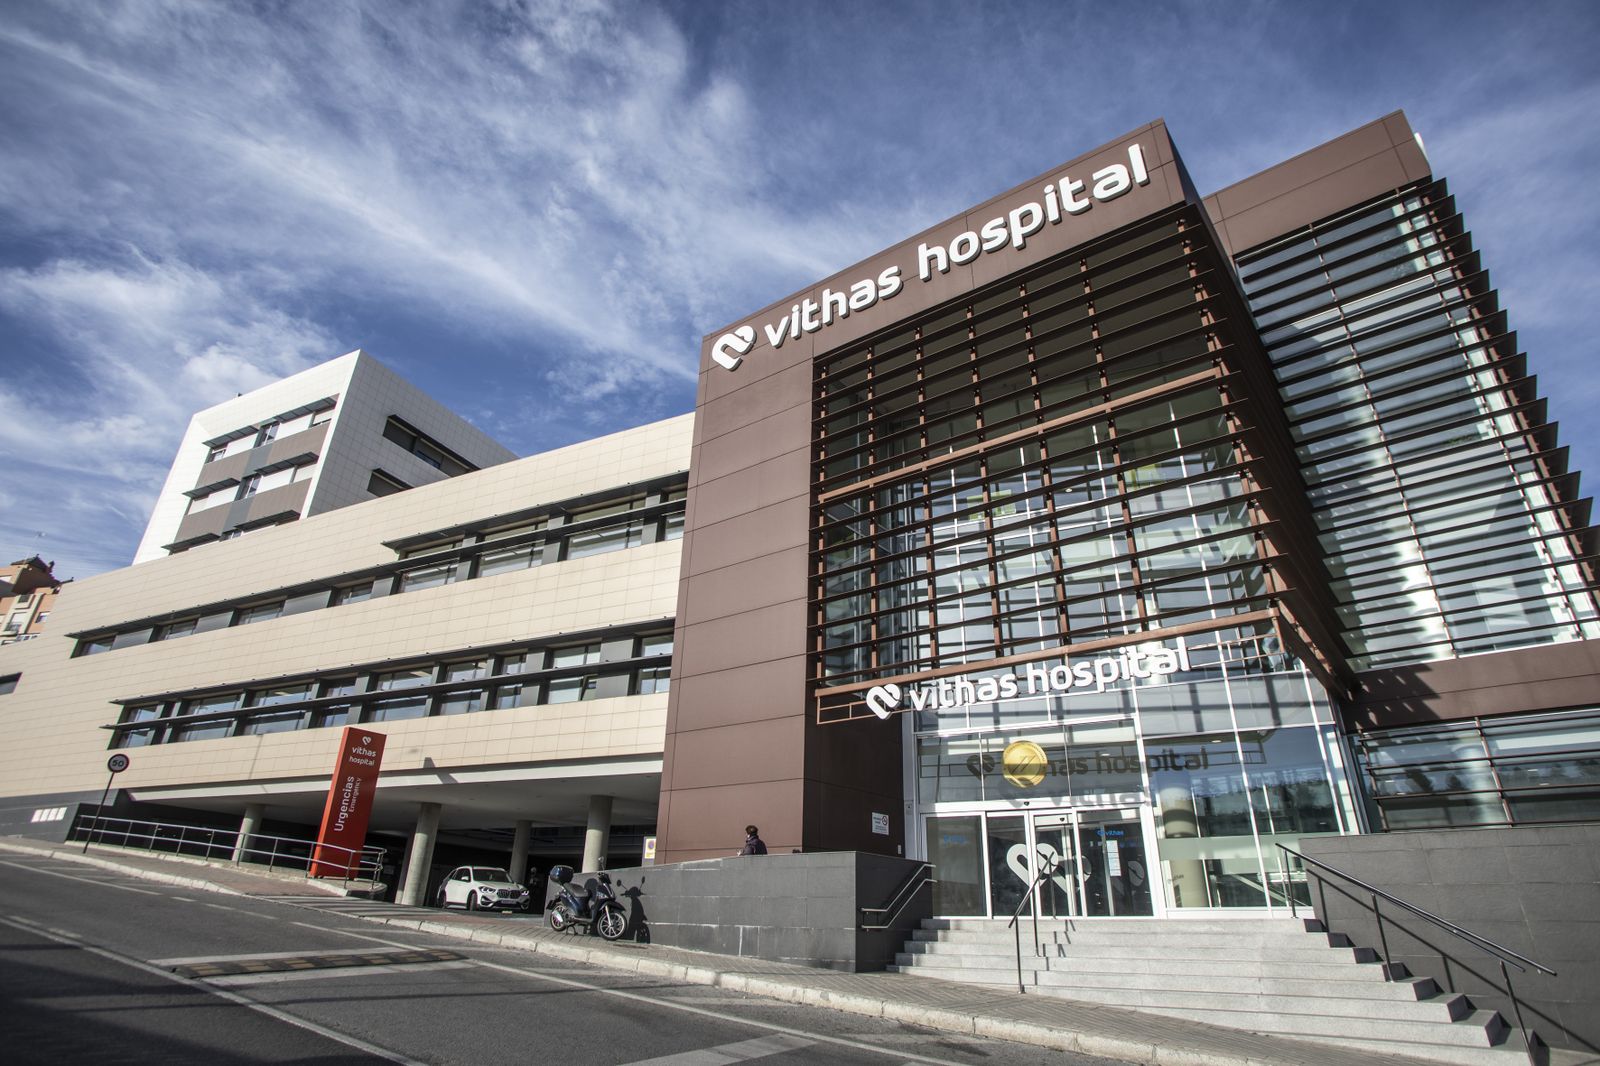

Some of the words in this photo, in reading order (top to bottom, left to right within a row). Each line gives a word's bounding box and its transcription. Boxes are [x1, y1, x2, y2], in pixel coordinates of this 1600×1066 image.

[764, 266, 903, 348] vithas
[918, 143, 1149, 280] hospital
[909, 673, 1019, 711] vithas
[1026, 636, 1190, 693] hospital
[349, 756, 375, 766] hospital
[352, 746, 376, 757] vithas
[334, 776, 355, 831] Urgencias
[348, 777, 362, 812] Emergency
